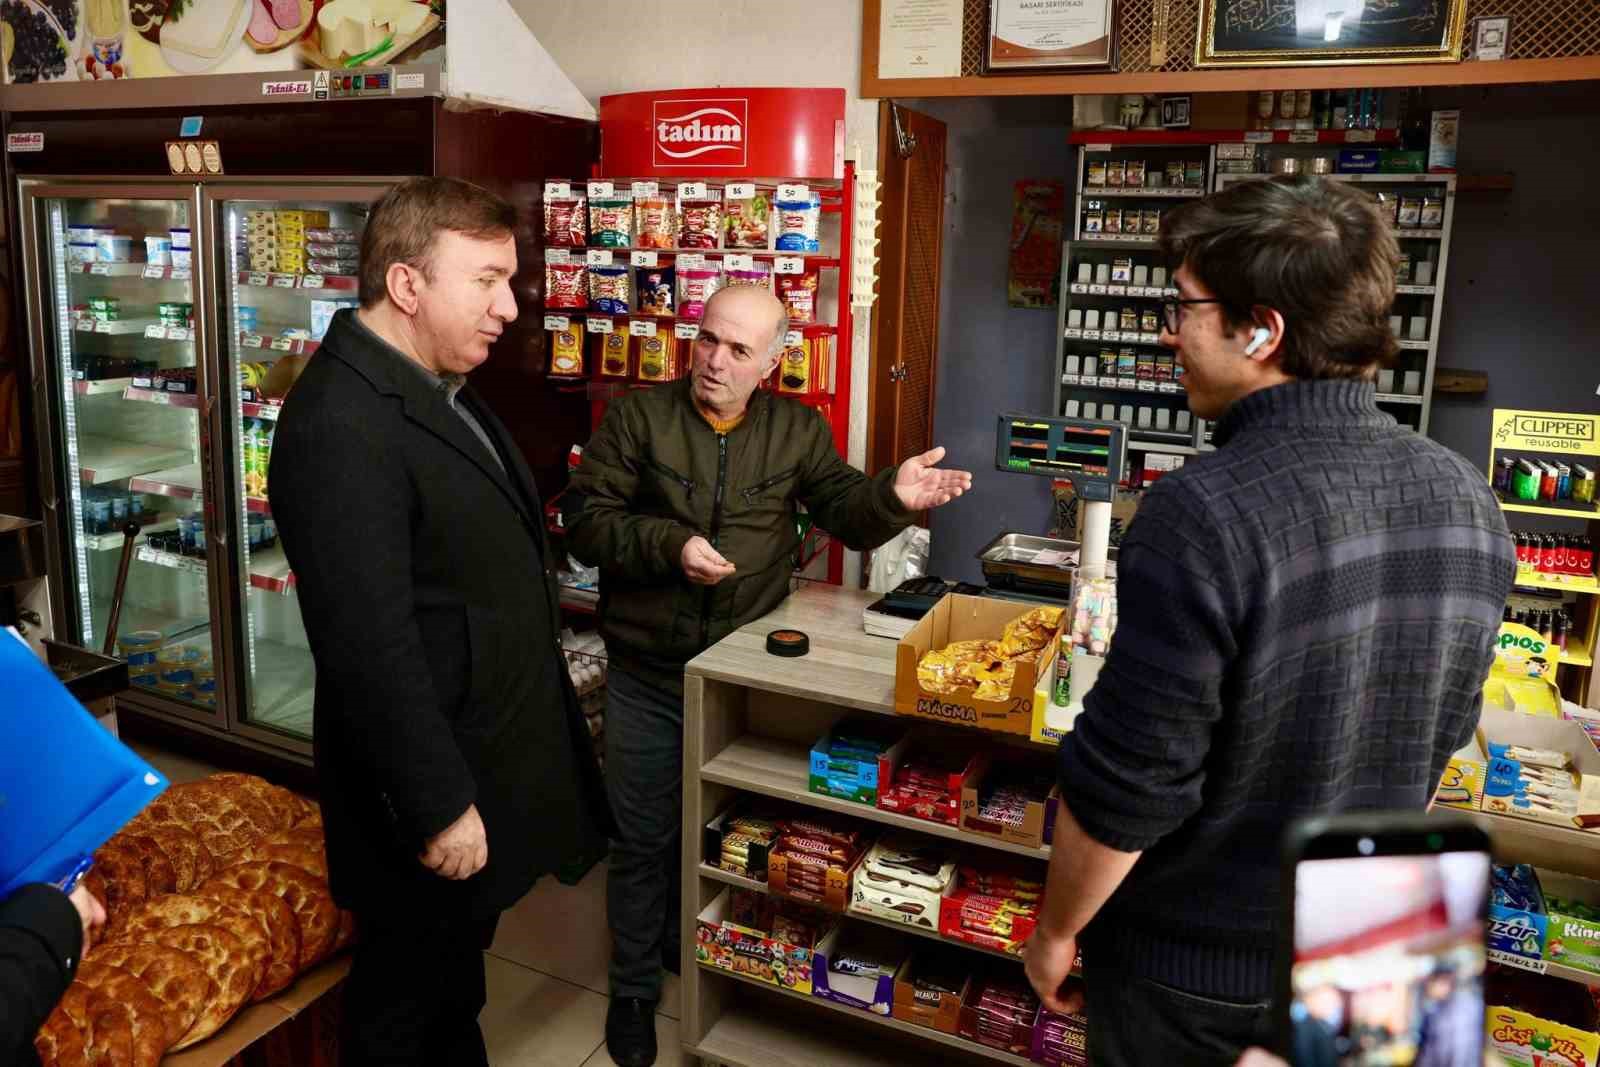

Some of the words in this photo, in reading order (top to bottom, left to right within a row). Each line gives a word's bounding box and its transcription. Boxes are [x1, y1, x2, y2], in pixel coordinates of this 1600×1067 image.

[656, 119, 743, 143] tadım
[1520, 419, 1587, 436] CLIPPER
[1525, 438, 1582, 450] reusable
[917, 699, 978, 721] MAGMA
[1009, 697, 1033, 714] 20
[1495, 761, 1513, 776] 40
